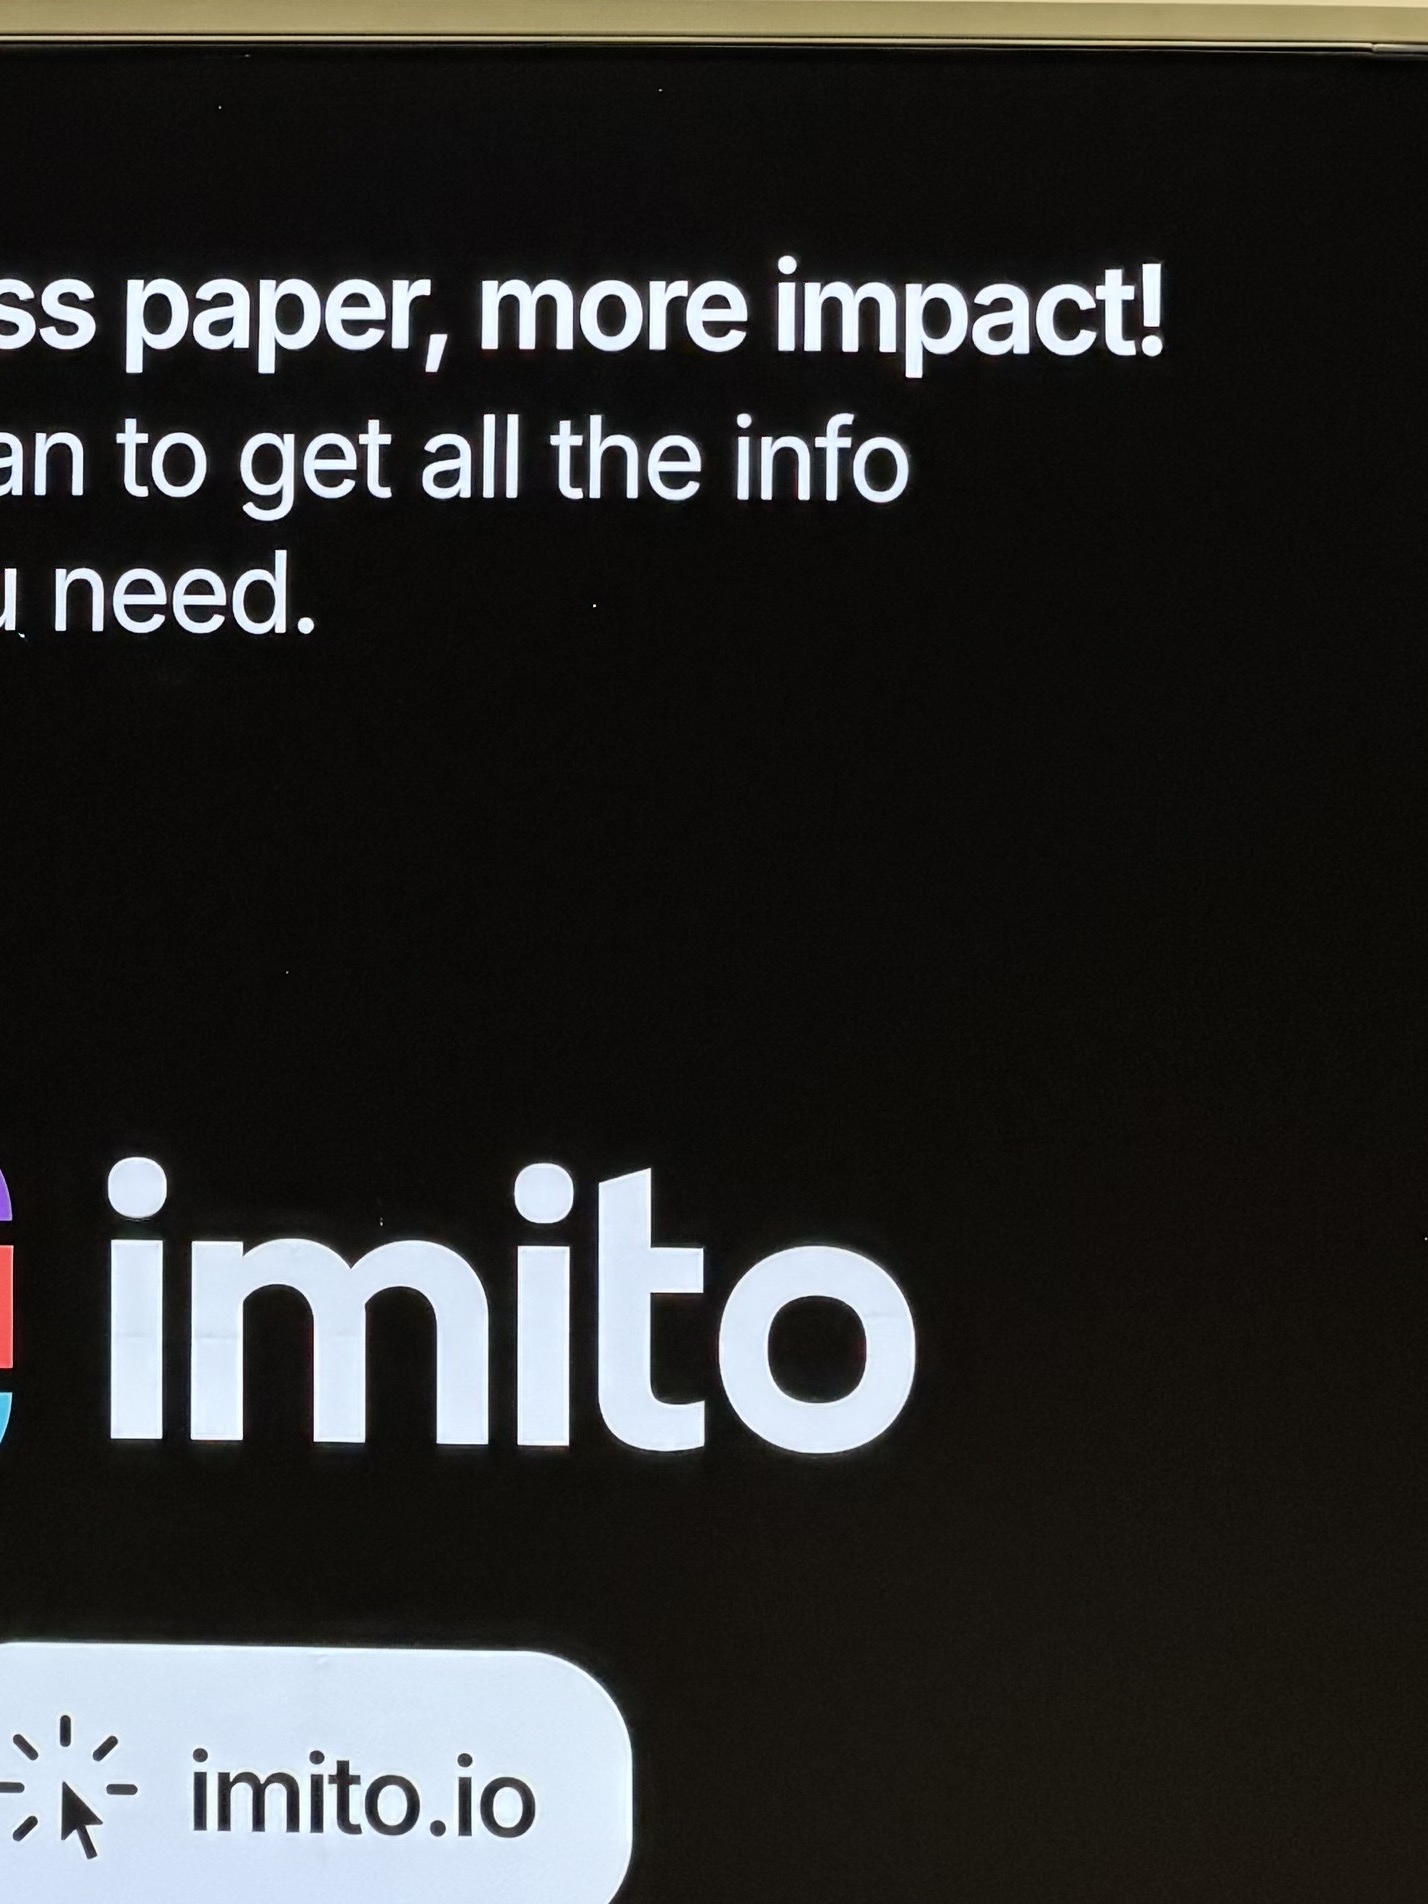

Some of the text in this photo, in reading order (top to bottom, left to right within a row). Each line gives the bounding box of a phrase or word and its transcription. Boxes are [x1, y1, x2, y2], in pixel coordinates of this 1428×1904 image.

[126, 279, 447, 373] paper,
[482, 280, 747, 352] more
[778, 256, 1163, 378] impact!
[116, 419, 206, 497] to
[240, 420, 392, 521] get
[422, 414, 518, 499] all
[550, 415, 701, 500] the
[737, 413, 909, 502] info
[55, 550, 314, 634] need.
[108, 1157, 916, 1453] imito
[193, 1748, 535, 1838] imito.io
